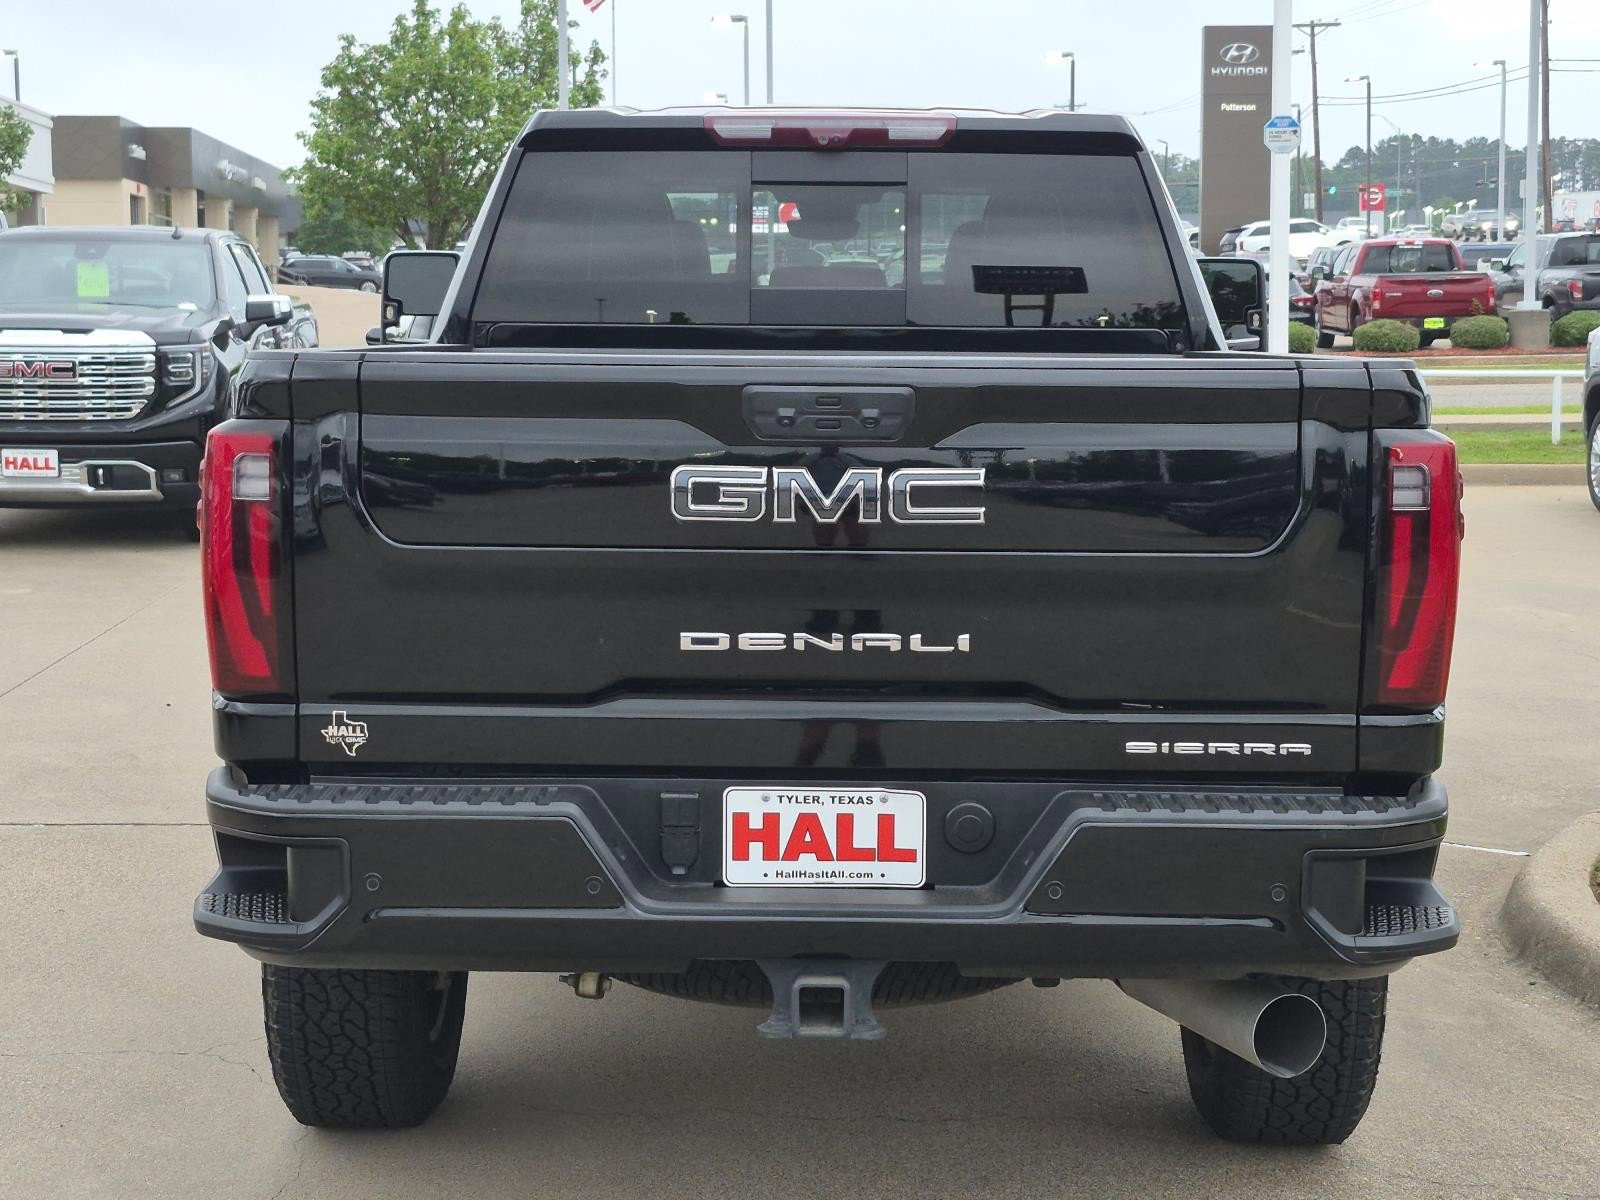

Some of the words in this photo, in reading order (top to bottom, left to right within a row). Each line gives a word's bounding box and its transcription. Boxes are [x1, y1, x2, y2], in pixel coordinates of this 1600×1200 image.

[1211, 67, 1268, 76] HYUNDAI
[1221, 103, 1256, 111] Patterson
[4, 456, 56, 469] HALL
[670, 465, 986, 524] GMC
[680, 632, 970, 652] DENALI
[328, 726, 364, 736] HALL
[1125, 742, 1312, 755] SIERRA
[777, 795, 825, 806] TYLER,
[829, 796, 874, 805] TEXAS
[732, 812, 917, 863] HALL
[775, 870, 874, 879] HallHasItAll.com
